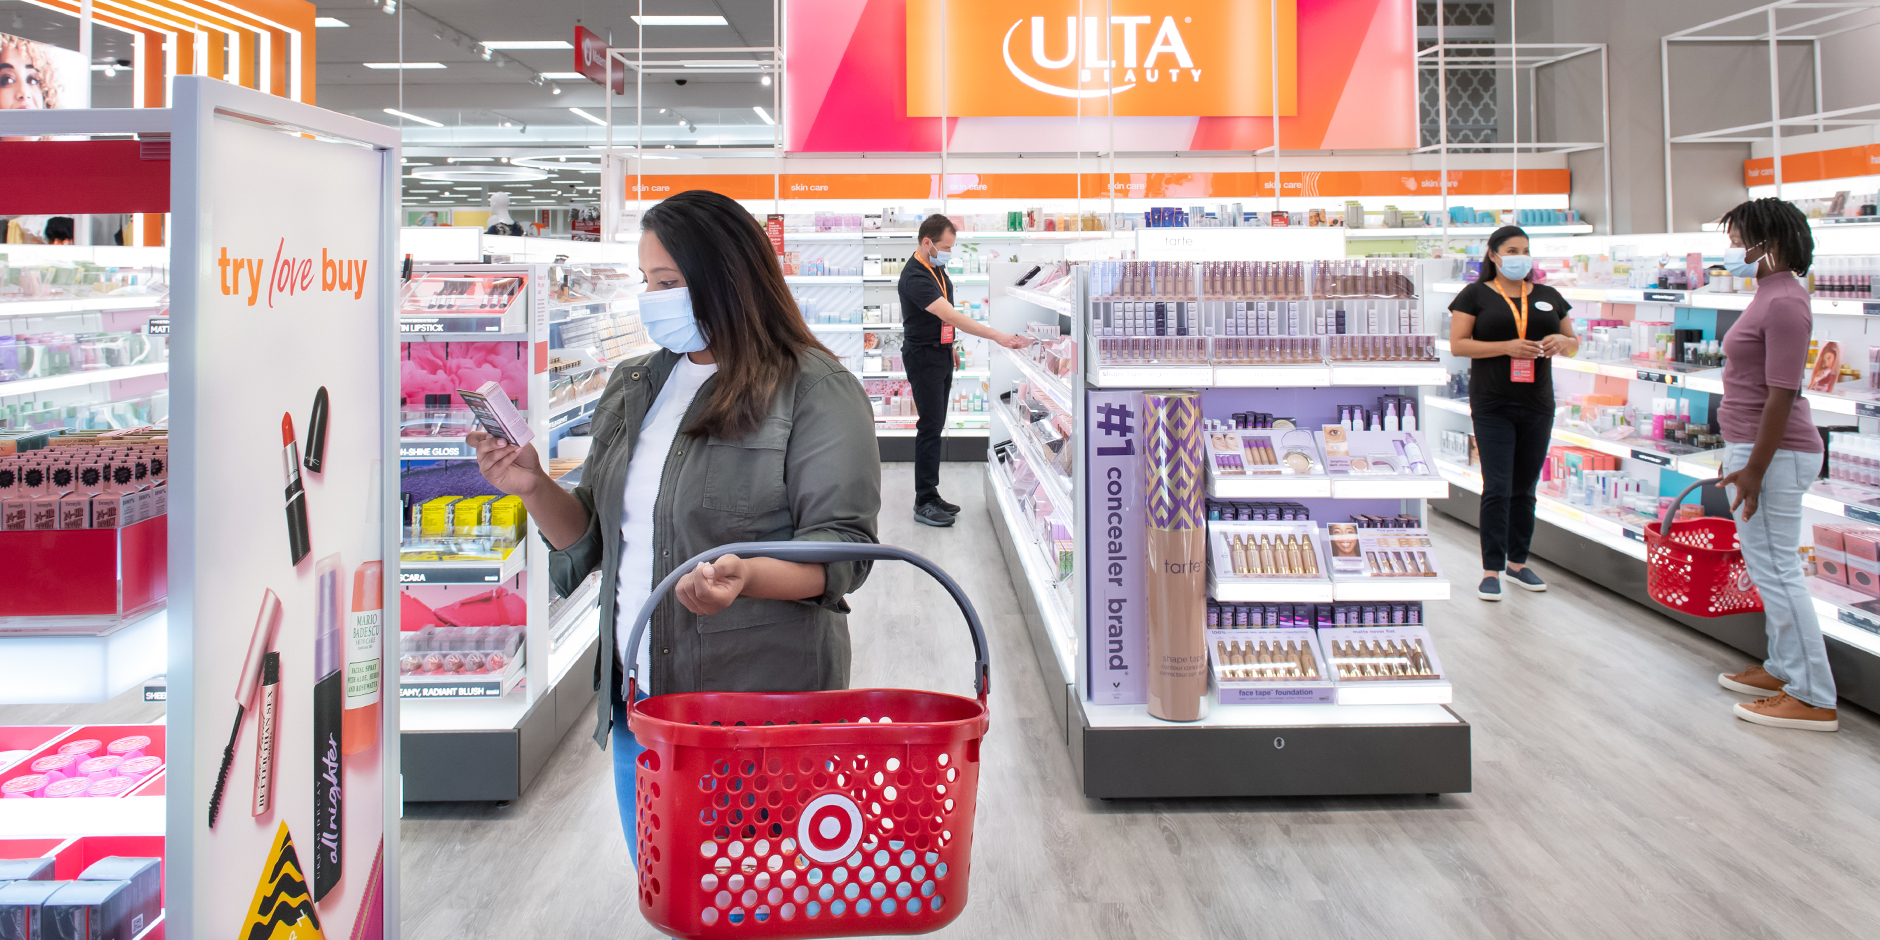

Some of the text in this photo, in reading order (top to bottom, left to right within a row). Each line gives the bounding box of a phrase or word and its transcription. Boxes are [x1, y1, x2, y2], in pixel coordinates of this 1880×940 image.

[1081, 69, 1202, 83] BEAUTY
[1748, 168, 1759, 177] hair
[790, 183, 808, 191] skin
[949, 183, 967, 191] skin
[1264, 181, 1281, 189] sk
[1164, 235, 1194, 247] tarte
[218, 237, 368, 308] try love buy
[410, 324, 444, 332] LIPSTICK
[1096, 402, 1136, 456] #1
[432, 447, 459, 456] GLOSS
[1107, 466, 1128, 588] concealer
[1164, 559, 1201, 574] tarte
[356, 614, 378, 627] MARIO
[352, 625, 380, 638] BADESCU
[1108, 598, 1129, 671] brand
[1163, 655, 1188, 664] shape
[423, 687, 457, 696] RADIANT
[458, 686, 485, 696] BLUSH
[259, 757, 267, 807] BETTER
